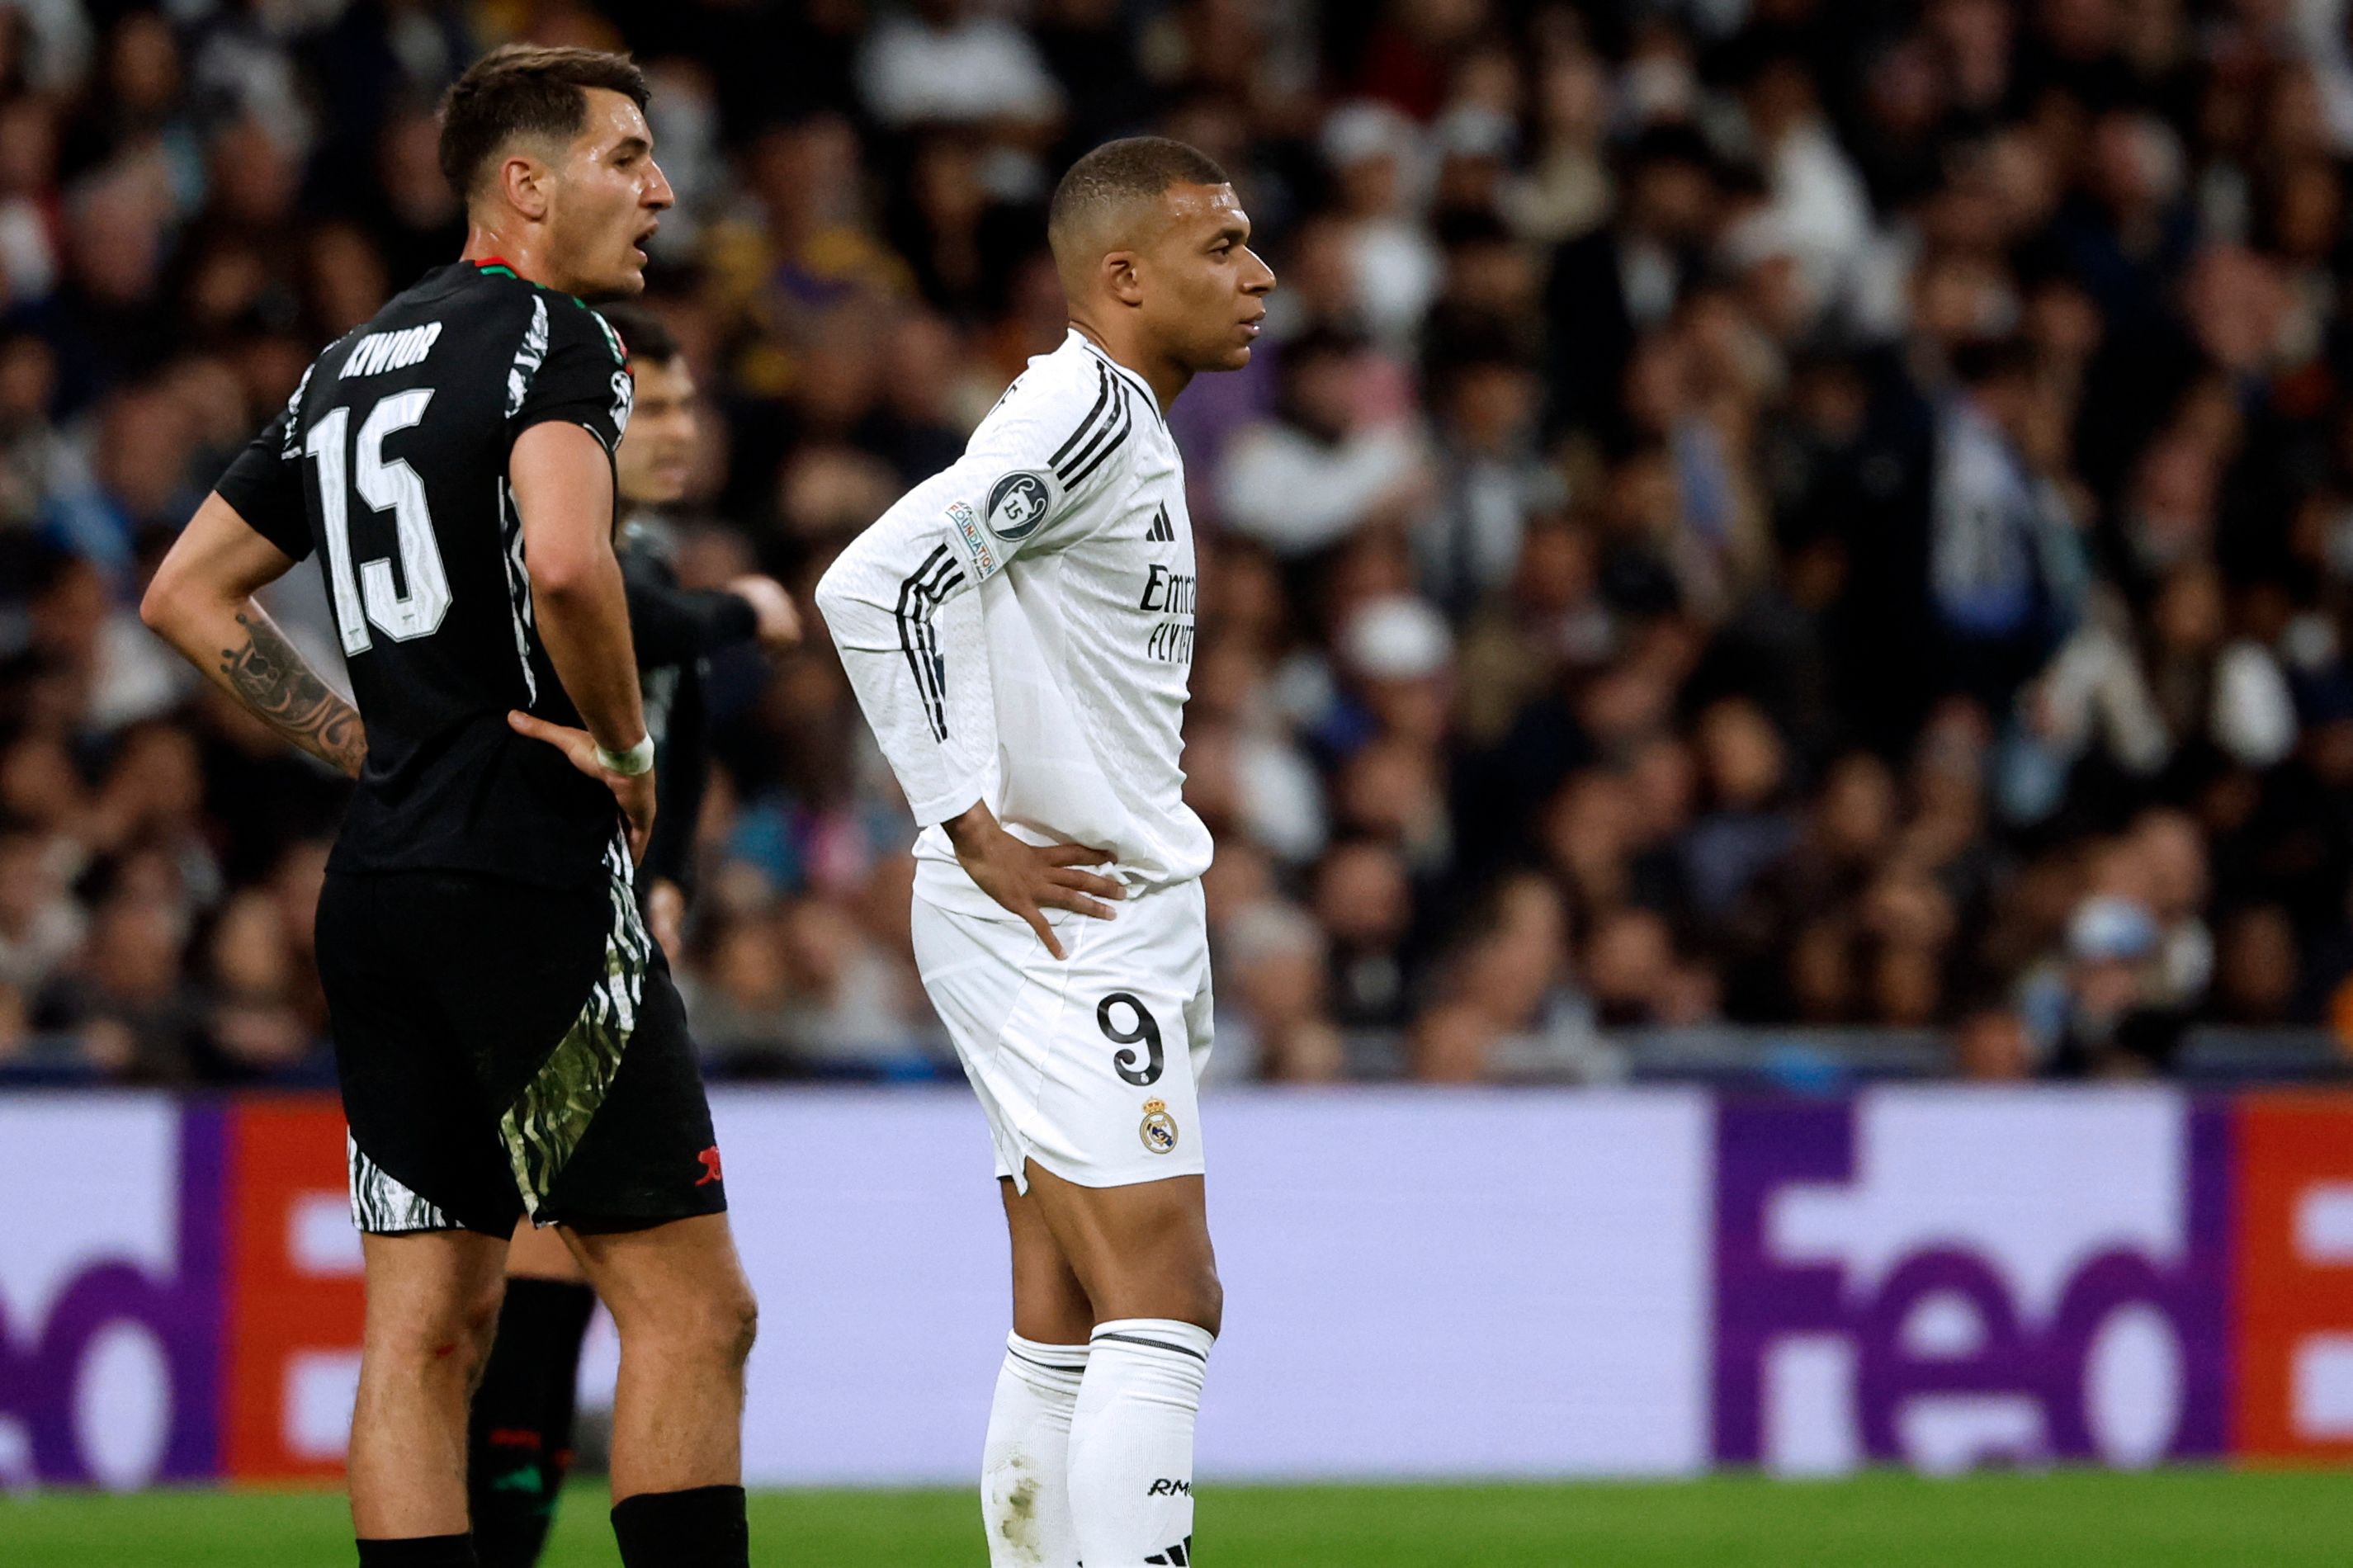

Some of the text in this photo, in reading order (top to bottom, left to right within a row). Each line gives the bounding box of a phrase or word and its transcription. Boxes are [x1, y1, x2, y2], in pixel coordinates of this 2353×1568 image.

[338, 321, 443, 380] KIWIOR
[305, 387, 453, 657] 15
[948, 503, 995, 575] FOUNDATION
[1004, 499, 1024, 520] 15
[1096, 992, 1165, 1087] 9
[1711, 1088, 2353, 1474] FedE
[1147, 1478, 1193, 1498] RM
